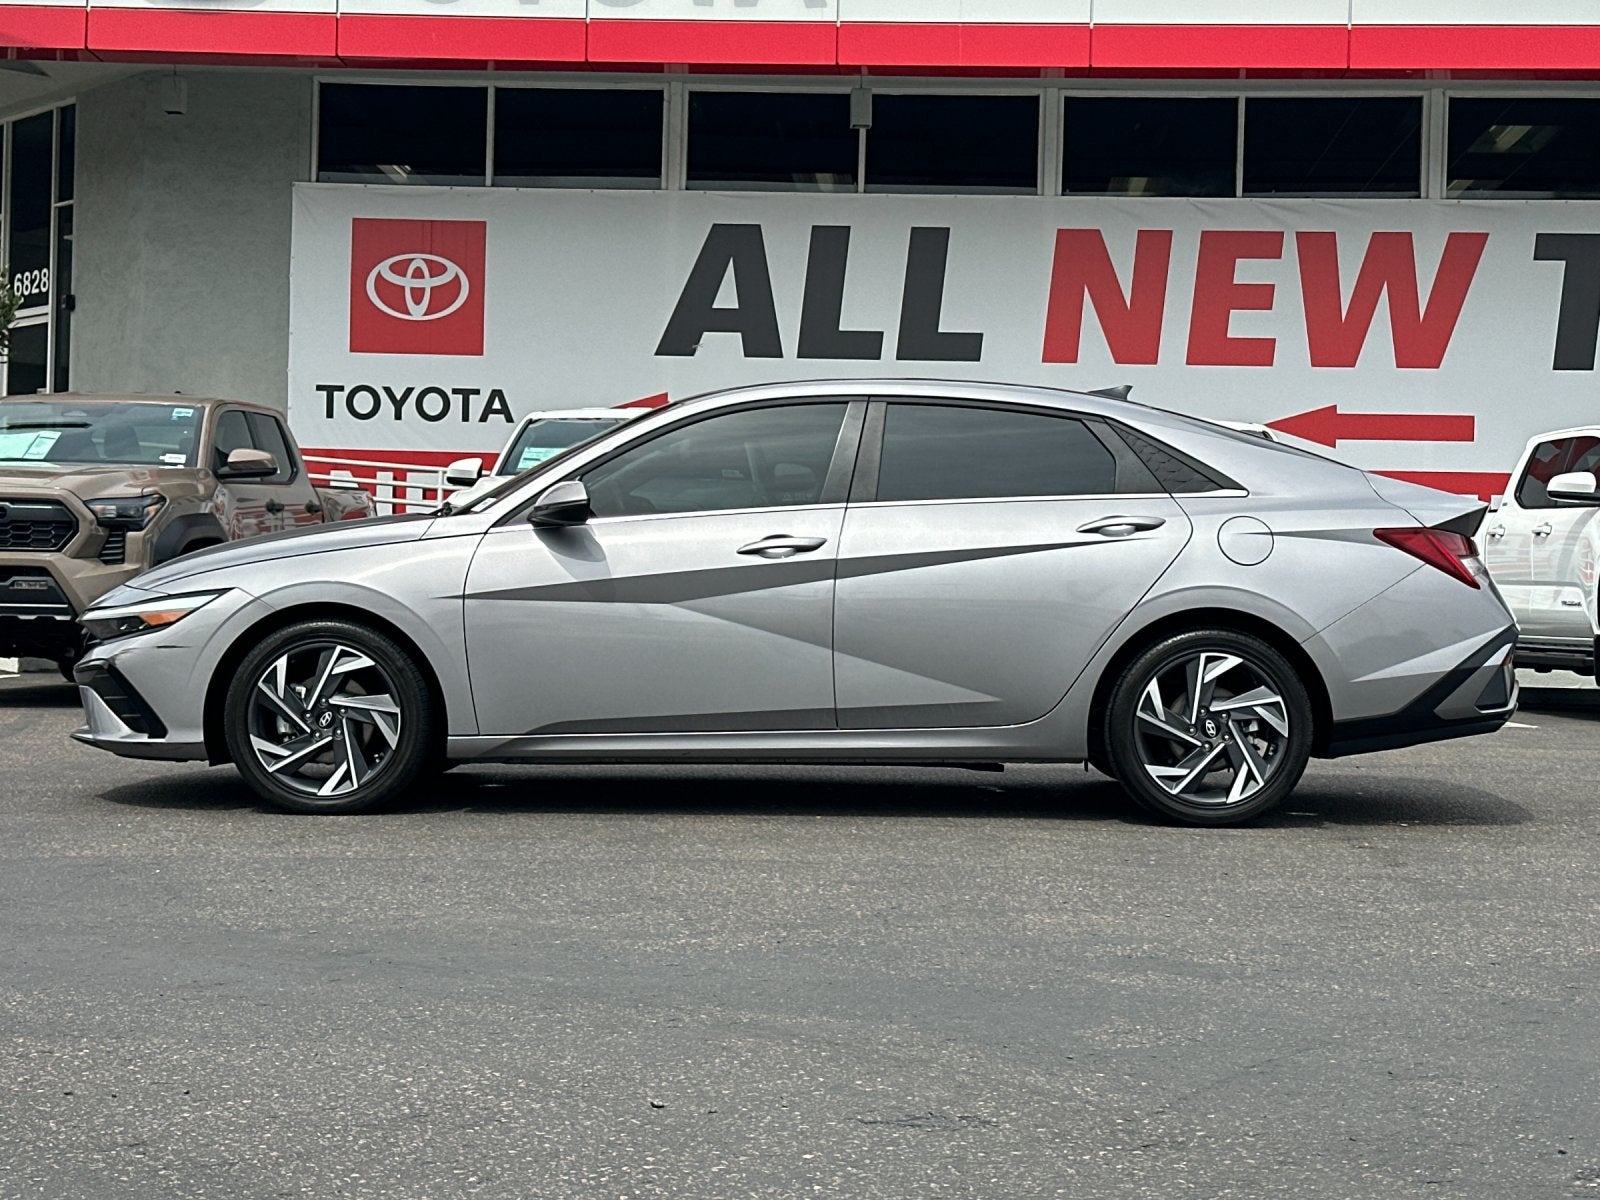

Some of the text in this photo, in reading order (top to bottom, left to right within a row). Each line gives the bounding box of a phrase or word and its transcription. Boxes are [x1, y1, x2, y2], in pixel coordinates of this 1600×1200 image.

[13, 267, 50, 297] 6828
[654, 223, 984, 362] ALL
[1042, 229, 1486, 369] NEW
[315, 384, 515, 424] TOYOTA
